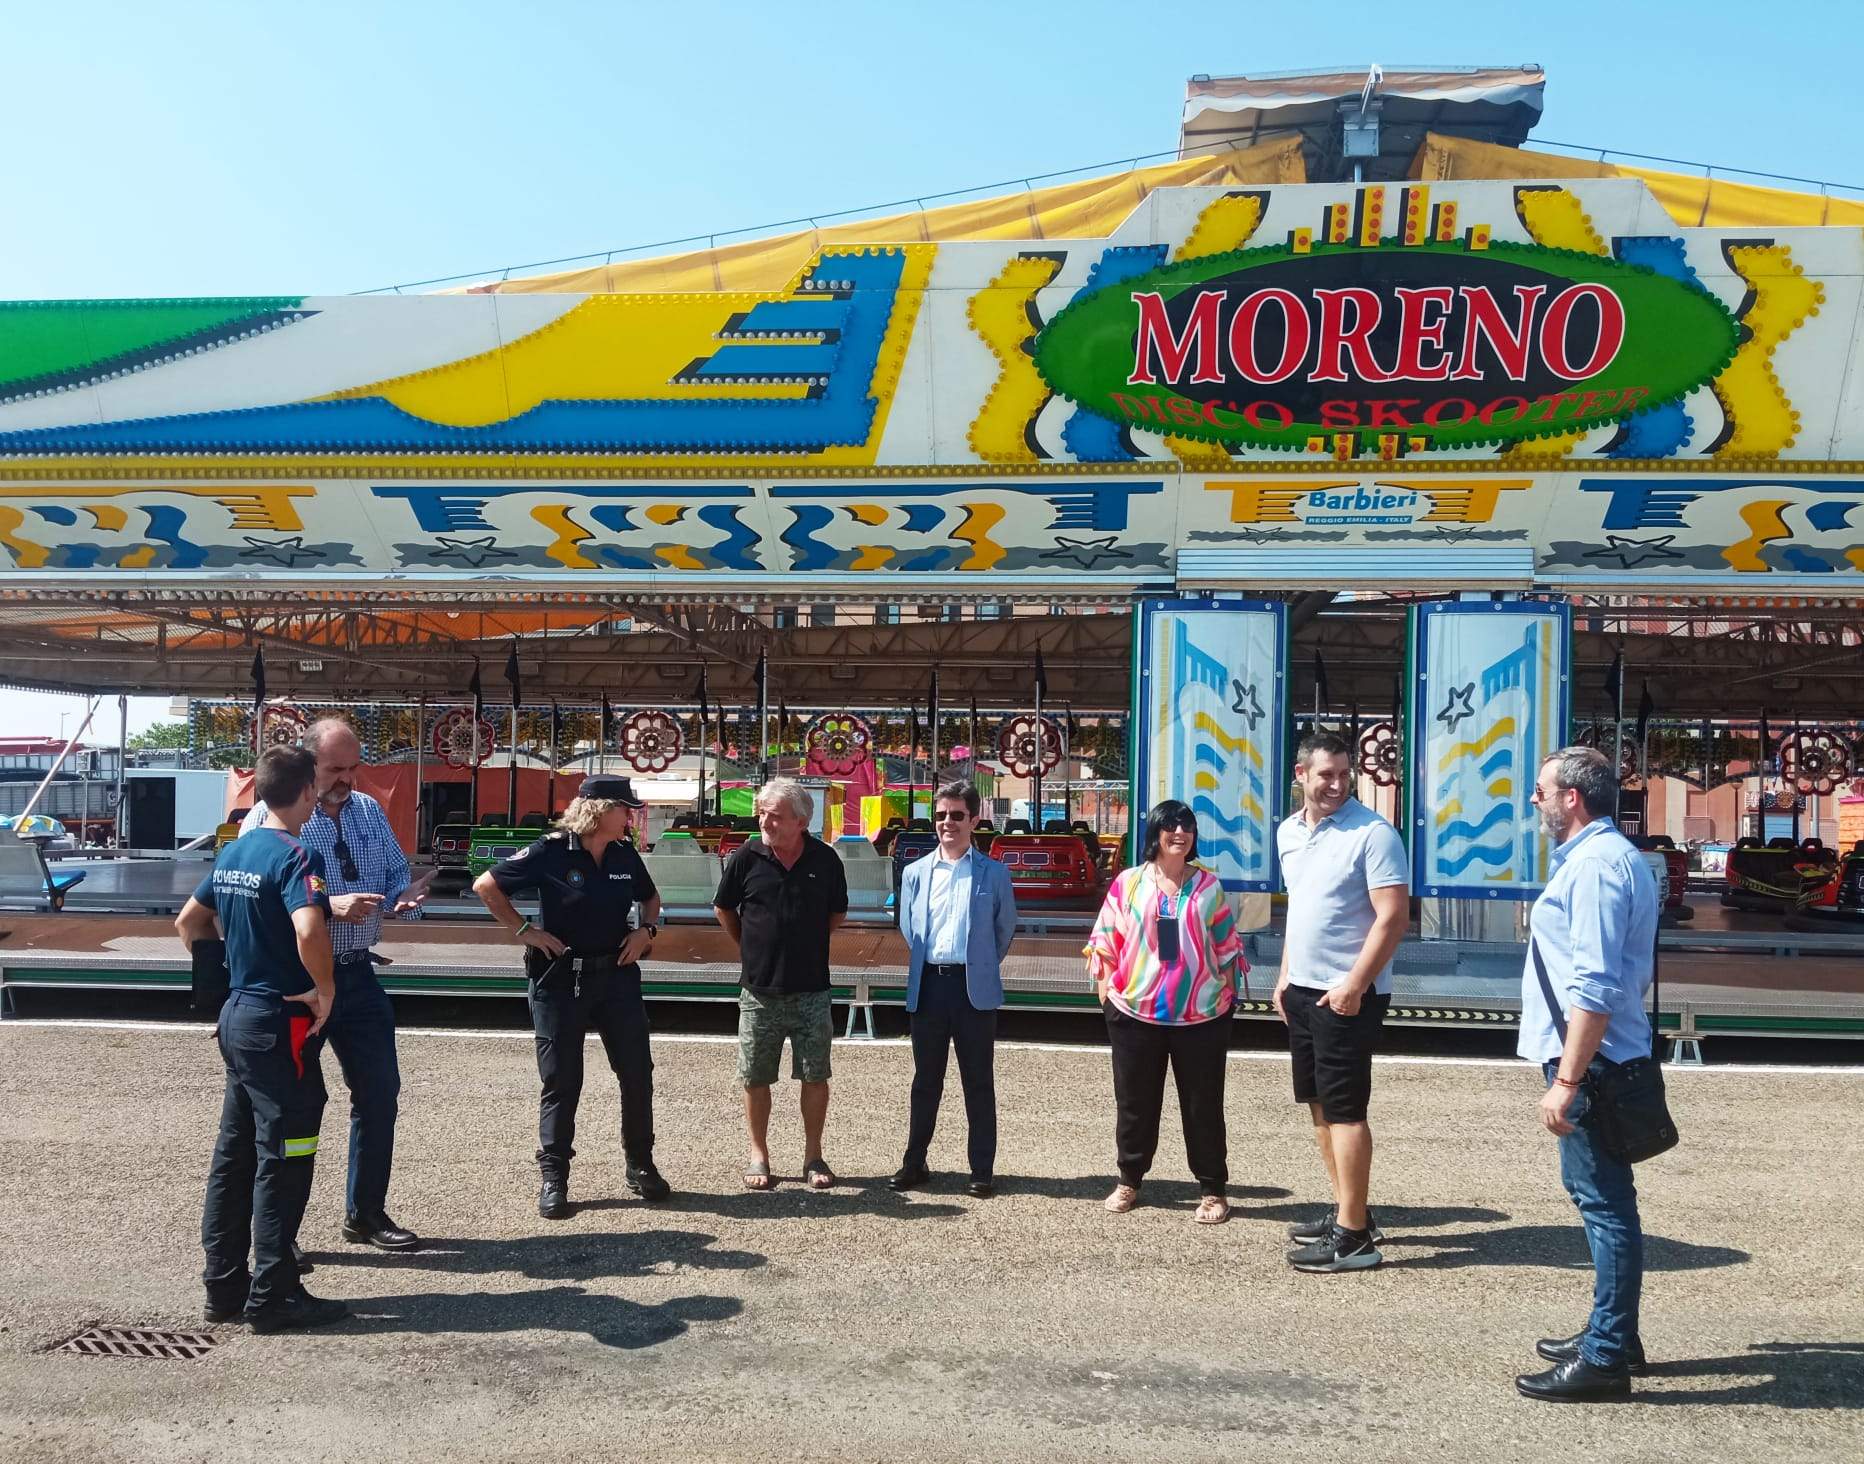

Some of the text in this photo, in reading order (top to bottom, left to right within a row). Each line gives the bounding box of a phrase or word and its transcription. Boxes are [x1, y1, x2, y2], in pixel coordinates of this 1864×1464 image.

[1127, 282, 1626, 386] MORENO
[1110, 386, 1649, 433] DISCO SKOOTER
[1308, 487, 1418, 511] Barbieri
[213, 869, 261, 889] BOMBEROS
